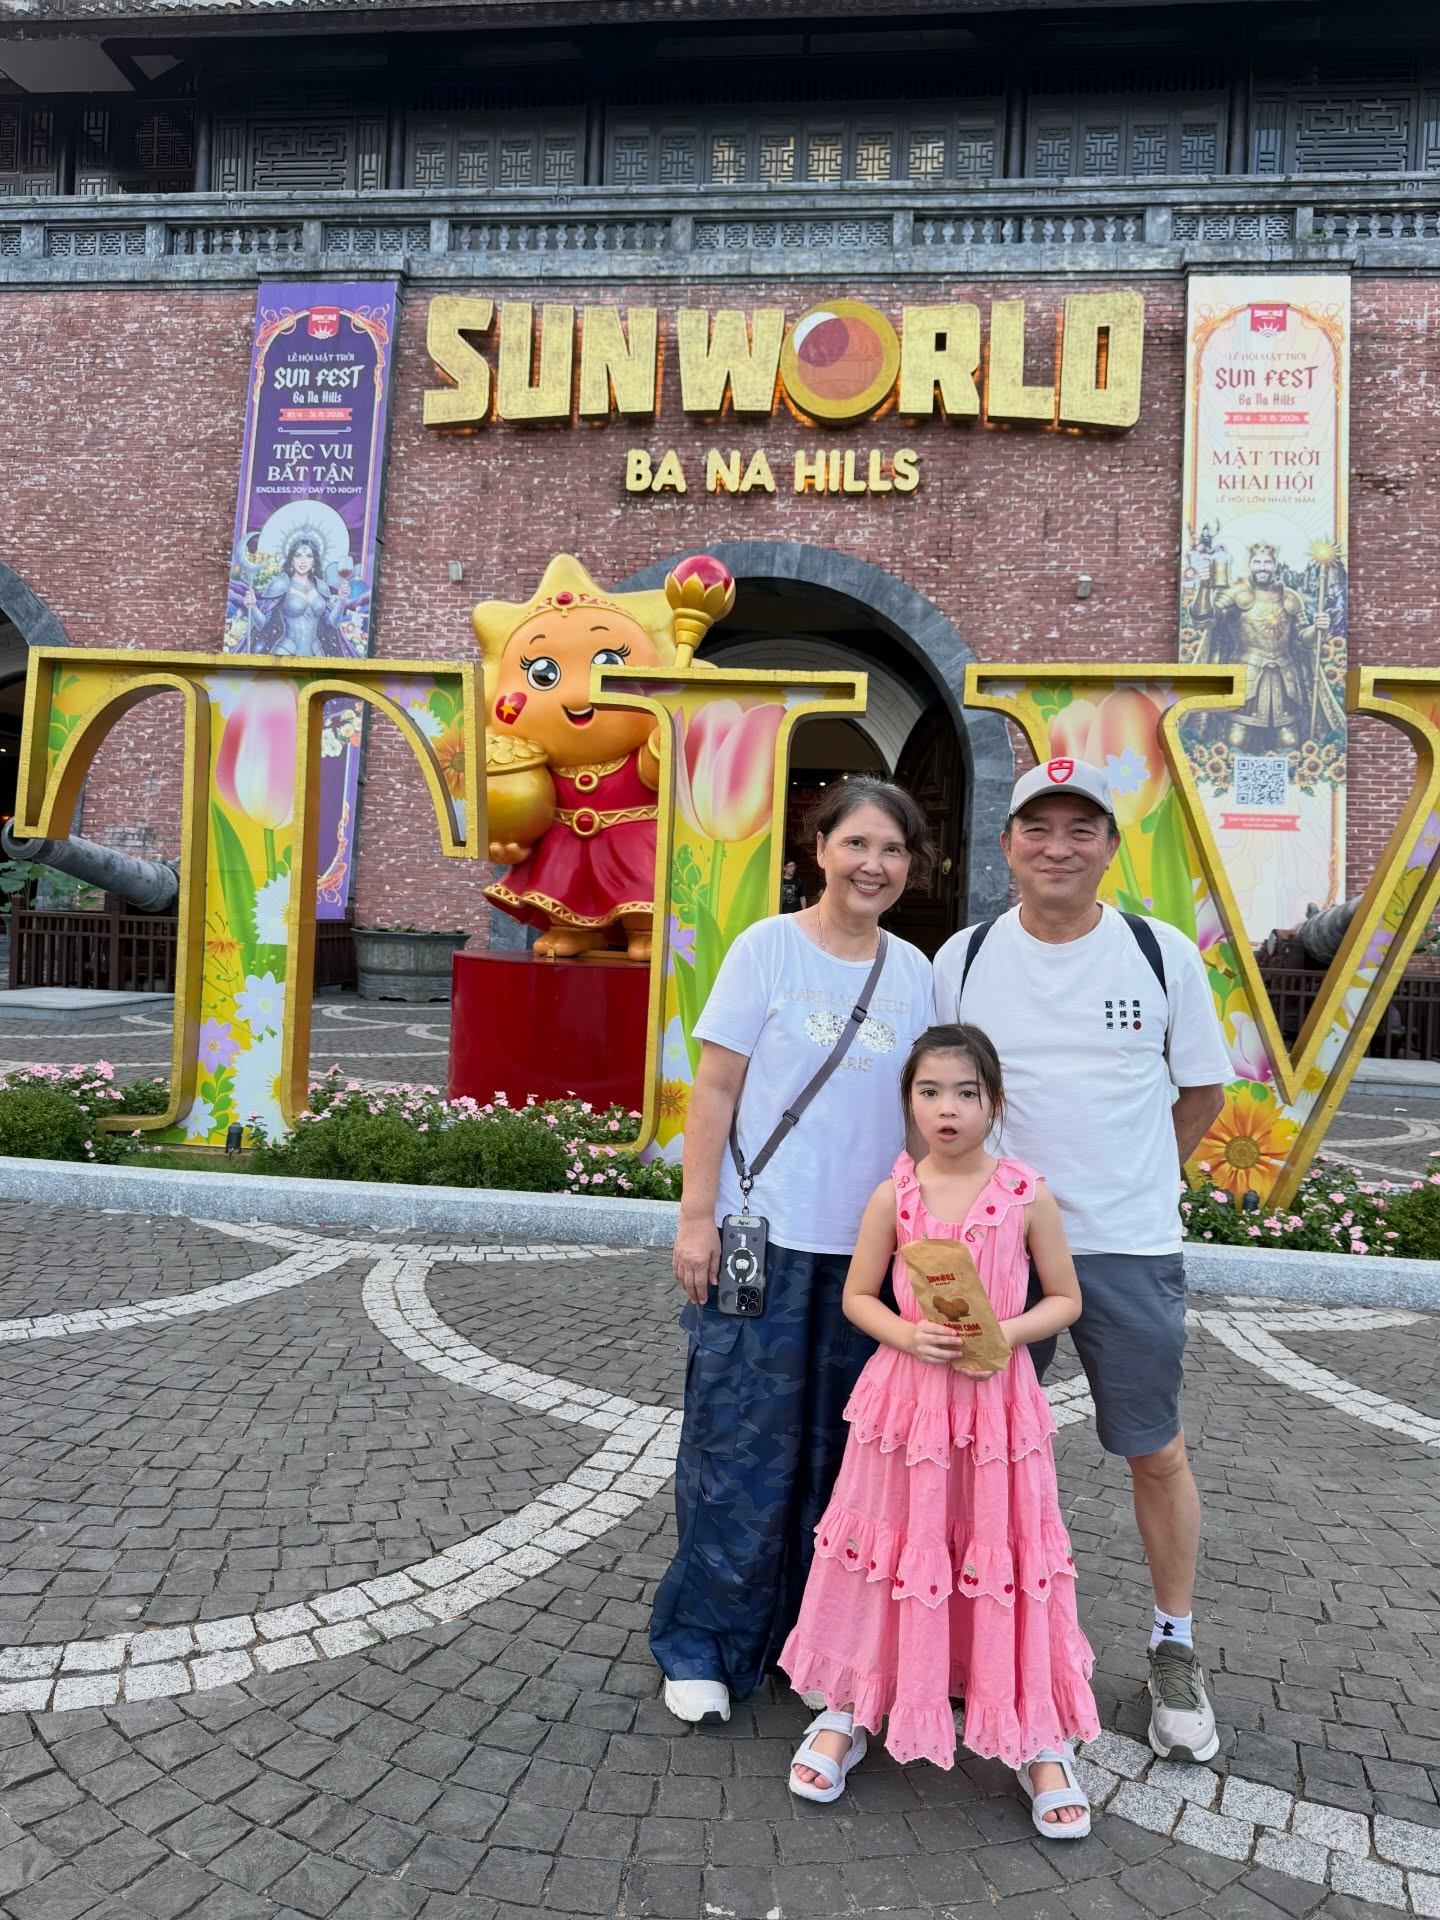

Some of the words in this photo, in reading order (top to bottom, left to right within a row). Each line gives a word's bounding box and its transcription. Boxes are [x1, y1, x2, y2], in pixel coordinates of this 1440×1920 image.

[422, 294, 660, 427] SUN
[677, 291, 1146, 428] WORLD
[322, 391, 343, 404] Hills
[1272, 393, 1296, 406] Hills
[272, 440, 314, 465] TIỆC
[319, 443, 353, 459] VUI
[1212, 447, 1263, 469] MẶT
[1269, 446, 1321, 467] TRỜI
[267, 460, 309, 482] BẤT
[313, 462, 355, 485] TẬN
[625, 448, 687, 494] BA
[705, 449, 776, 493] NA
[793, 449, 920, 493] HILLS
[1217, 474, 1269, 490] KHAI
[1276, 471, 1314, 494] HỘI
[256, 486, 291, 494] ENDLESS
[292, 486, 308, 494] JOY
[308, 486, 325, 494] DAY
[326, 486, 335, 494] TO
[337, 486, 363, 494] NIGHT
